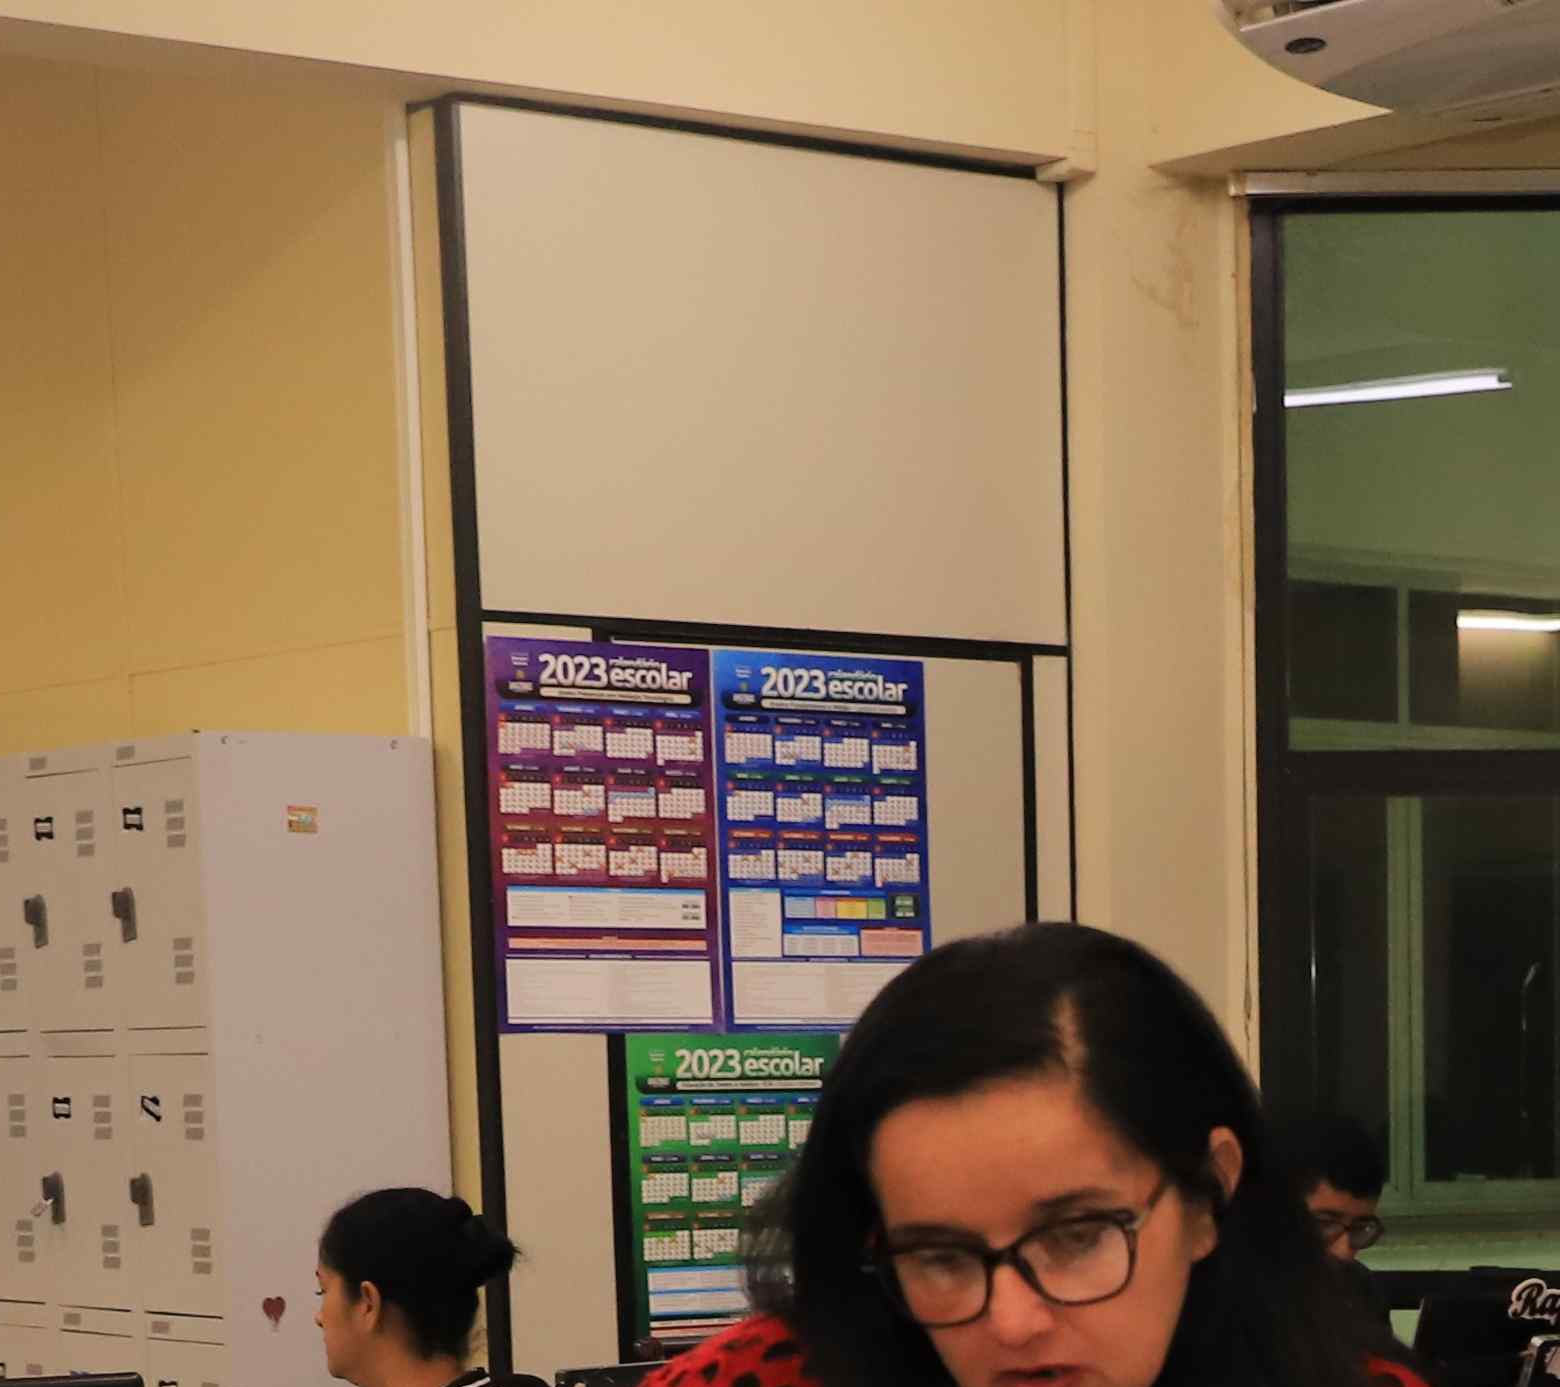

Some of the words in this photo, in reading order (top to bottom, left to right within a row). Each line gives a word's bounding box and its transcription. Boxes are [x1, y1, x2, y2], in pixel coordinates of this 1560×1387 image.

[538, 653, 607, 688] 2023
[609, 662, 694, 690] escolar
[760, 666, 826, 699] 2023
[827, 674, 908, 703] escolar
[675, 1048, 742, 1079] 2023
[743, 1051, 824, 1077] escolar
